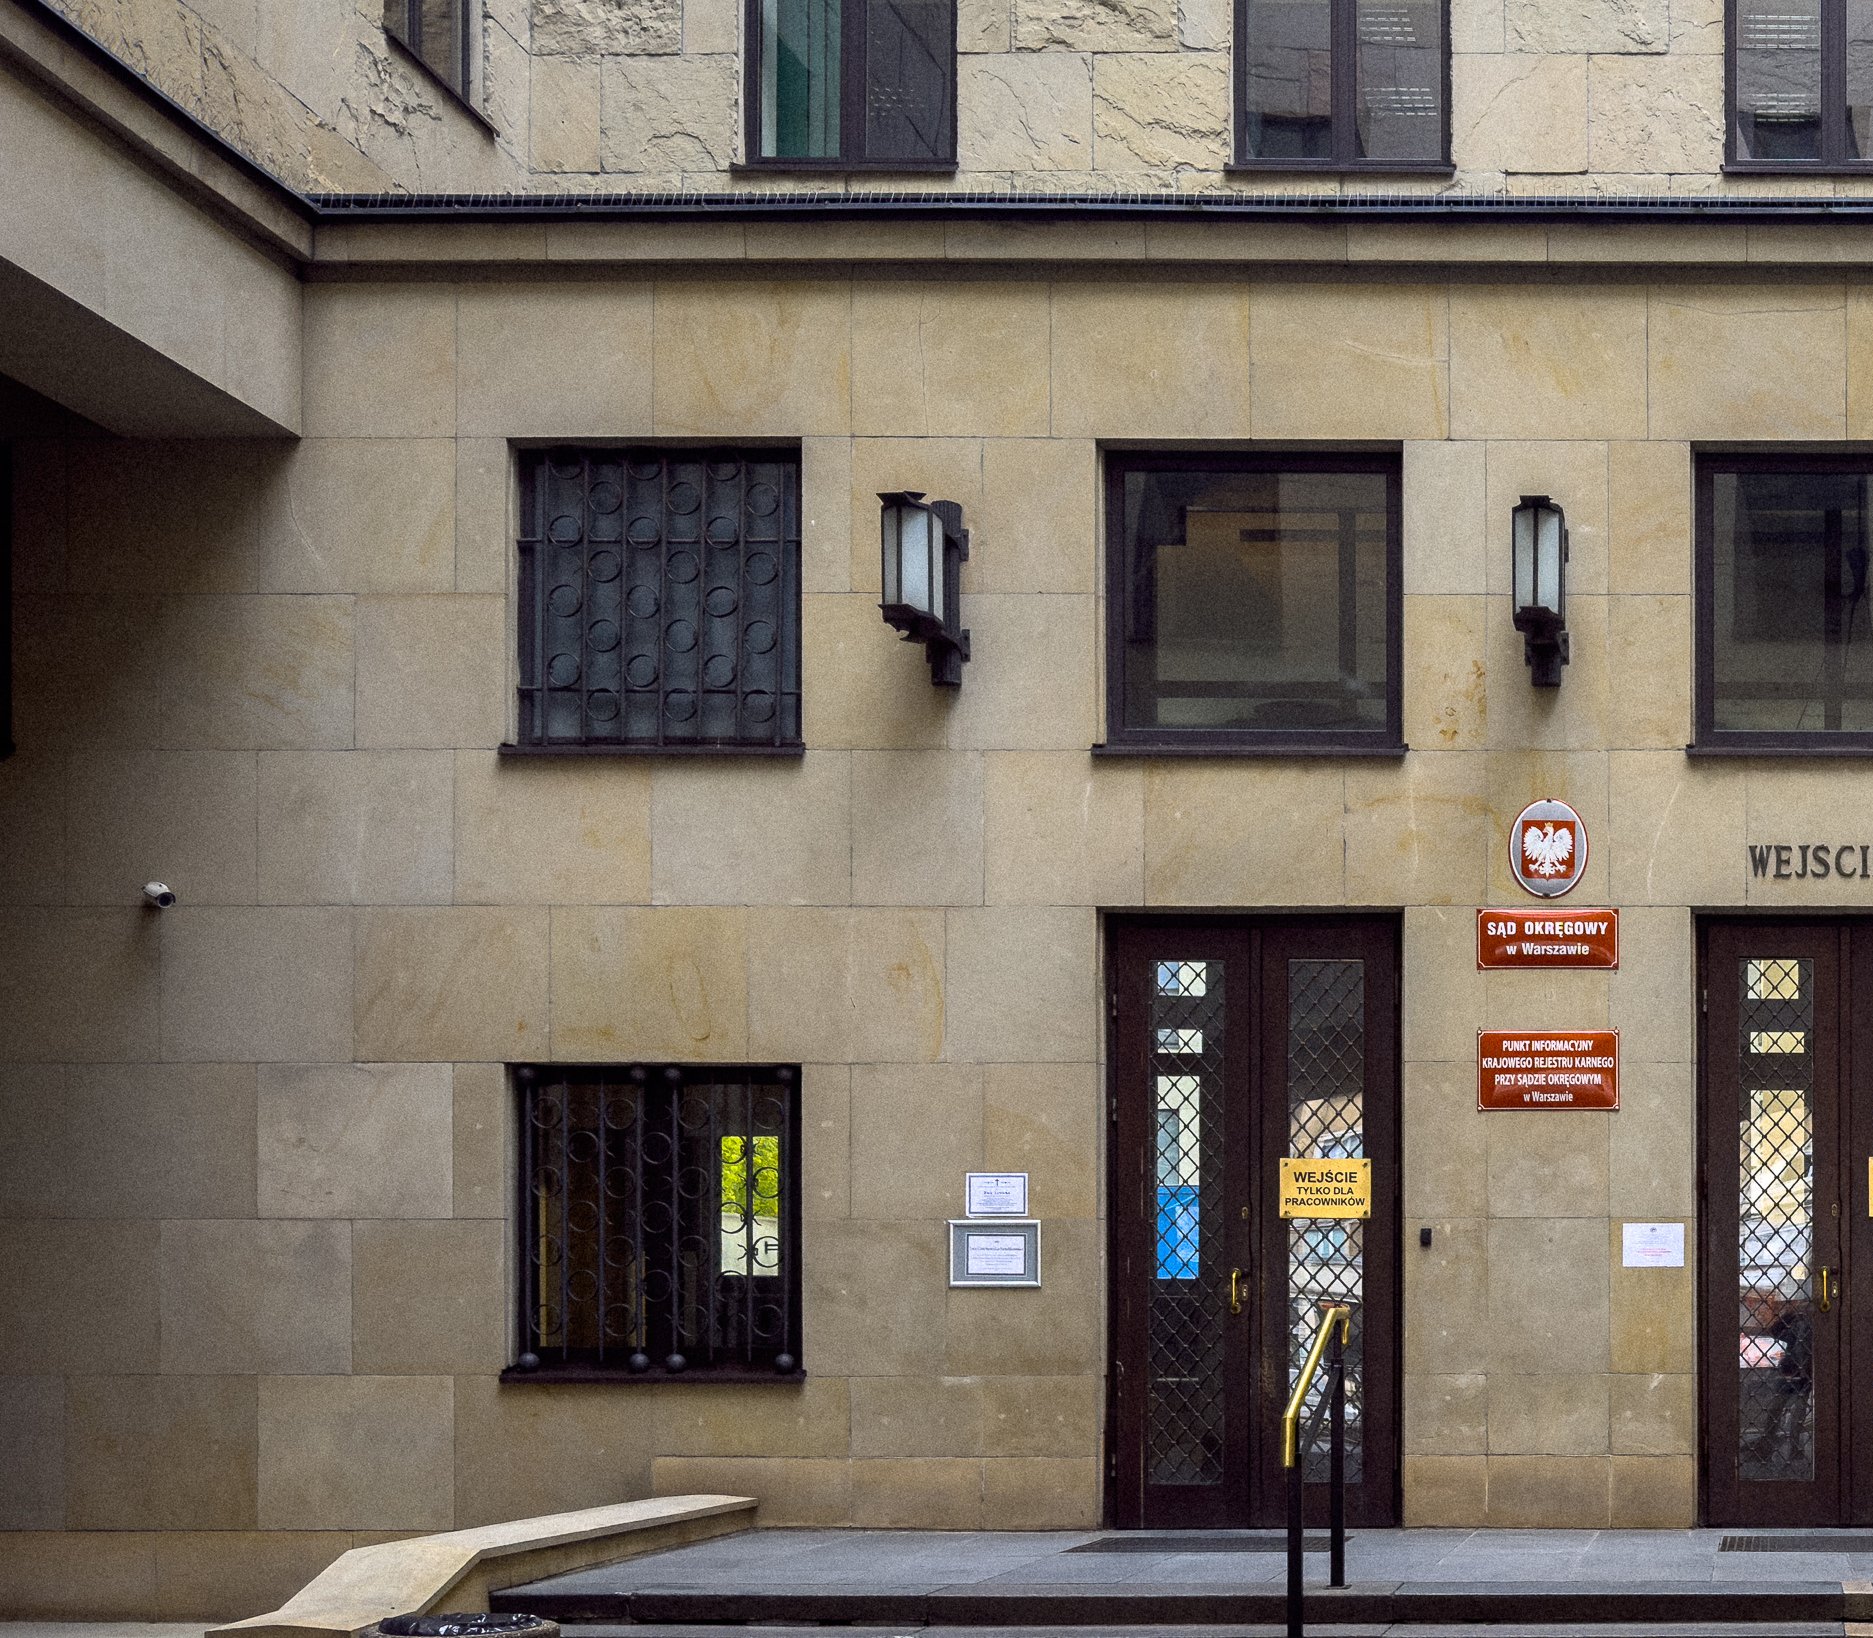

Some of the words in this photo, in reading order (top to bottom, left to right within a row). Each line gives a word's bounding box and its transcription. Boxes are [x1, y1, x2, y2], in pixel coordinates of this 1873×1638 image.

[1487, 921, 1517, 938] SĄD
[1524, 921, 1608, 938] OKRĘGOWY
[1506, 945, 1517, 955] w
[1522, 943, 1590, 955] Warszawie
[1502, 1040, 1530, 1052] PUNKT
[1532, 1040, 1594, 1052] INFORMACYJNY
[1482, 1057, 1533, 1069] KRAJOWEGO
[1534, 1057, 1573, 1068] REJESTRU
[1575, 1057, 1614, 1068] KARNEGO
[1494, 1074, 1515, 1085] PRZY
[1517, 1074, 1546, 1087] SĄDZIE
[1548, 1074, 1602, 1087] OKRĘGOWYM
[1523, 1093, 1531, 1102] w
[1532, 1091, 1573, 1102] Warszawie
[1294, 1169, 1358, 1183] WEJŚCIE
[1297, 1186, 1331, 1195] TYLKO
[1333, 1186, 1354, 1195] DLA
[1284, 1196, 1365, 1206] PRACOWNIKÓW
